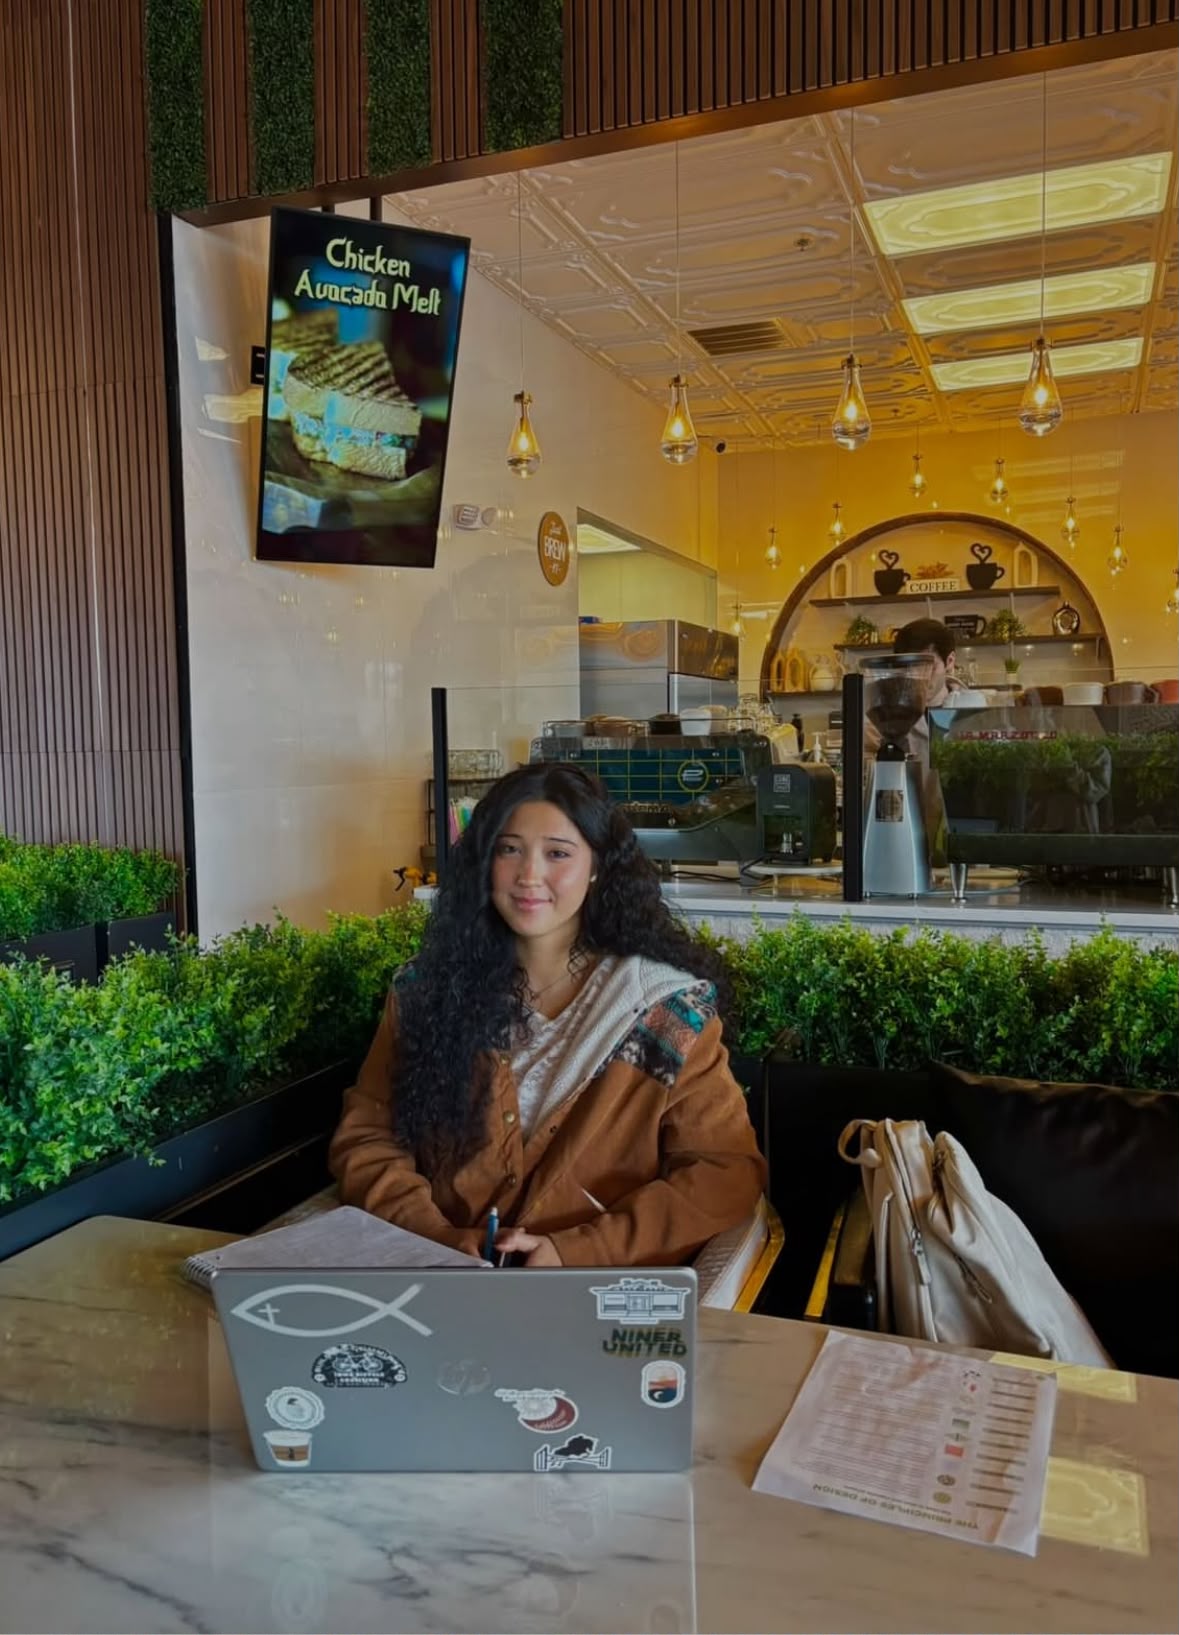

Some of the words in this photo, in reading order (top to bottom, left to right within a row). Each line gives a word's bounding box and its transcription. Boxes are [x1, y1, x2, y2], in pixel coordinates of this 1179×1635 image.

[326, 237, 410, 278] Chicken
[294, 270, 387, 309] Avocado
[392, 283, 441, 316] Melt
[544, 536, 566, 562] BREW
[909, 580, 958, 592] COFFEE
[611, 1327, 682, 1343] NINER
[602, 1340, 688, 1357] UNITED
[812, 1484, 859, 1501] DESIGN
[859, 1497, 877, 1507] OF
[879, 1501, 952, 1525] PRINCIPLES
[955, 1519, 979, 1529] THE
